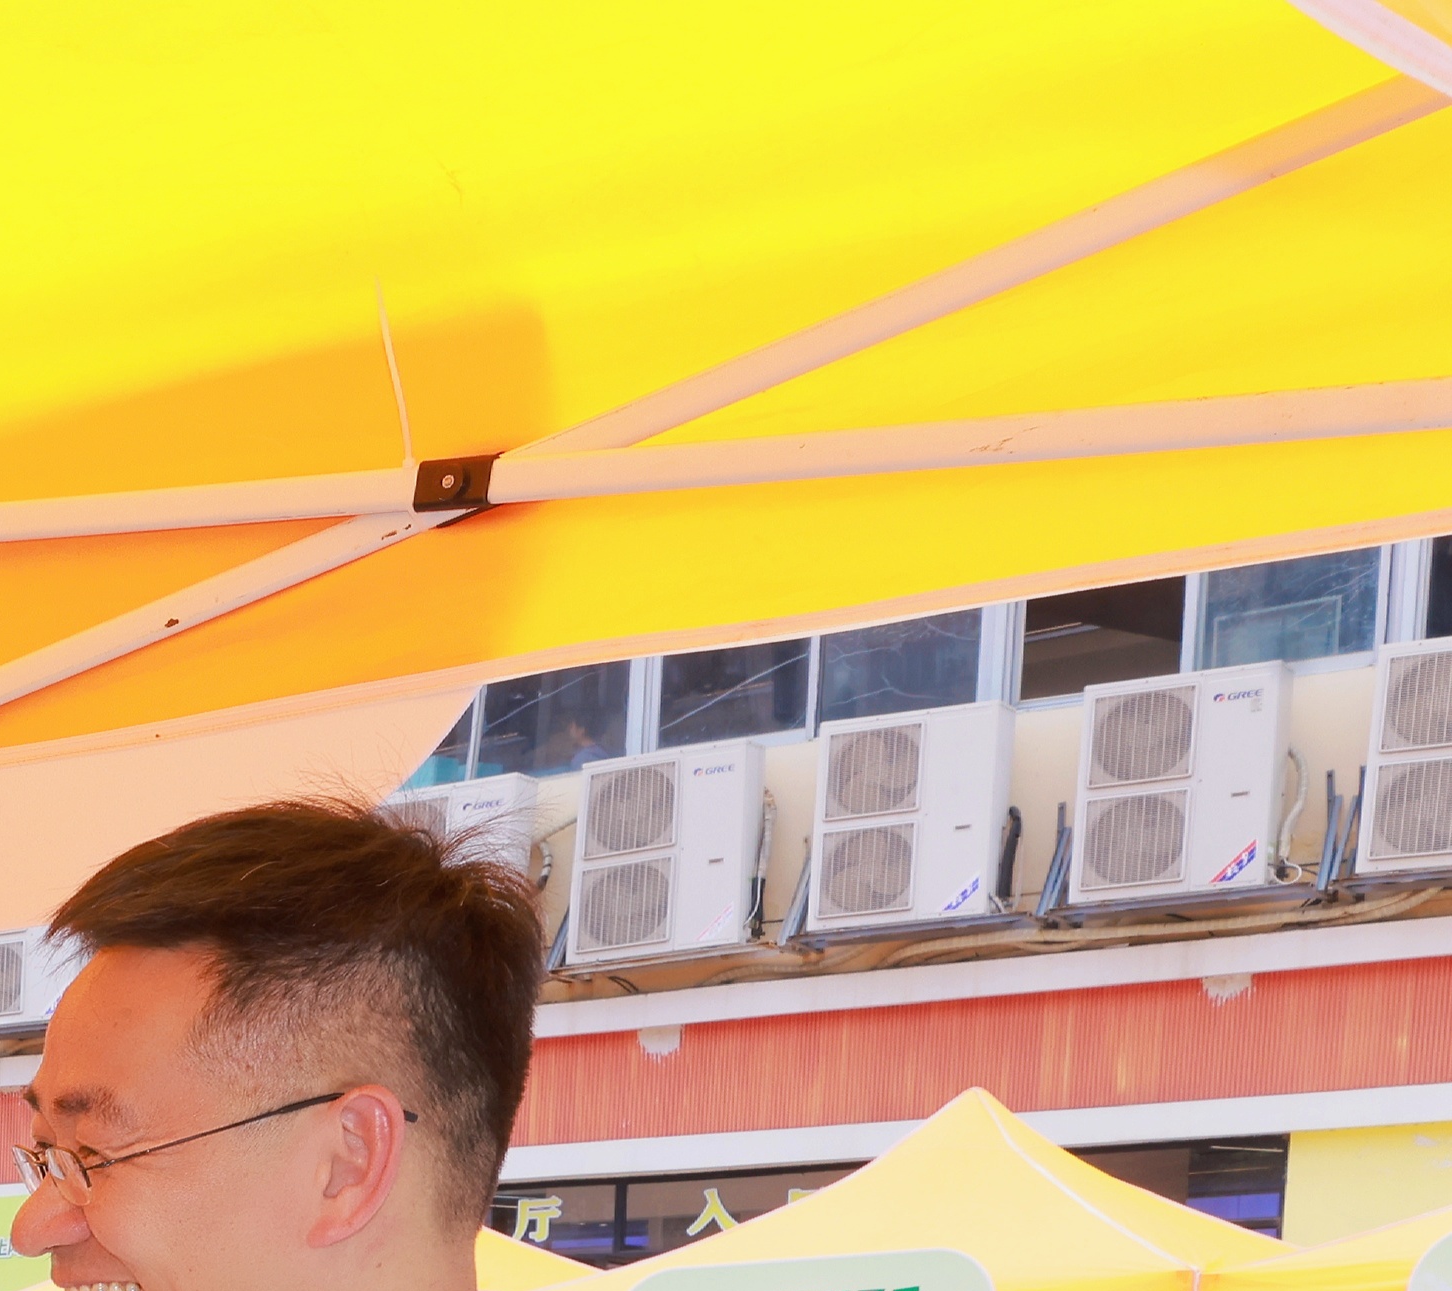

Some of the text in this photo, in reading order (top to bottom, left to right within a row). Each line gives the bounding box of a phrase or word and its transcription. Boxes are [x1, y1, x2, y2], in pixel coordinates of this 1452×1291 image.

[1227, 688, 1265, 701] GREE
[704, 764, 735, 775] GREE
[512, 1196, 563, 1242] 厅
